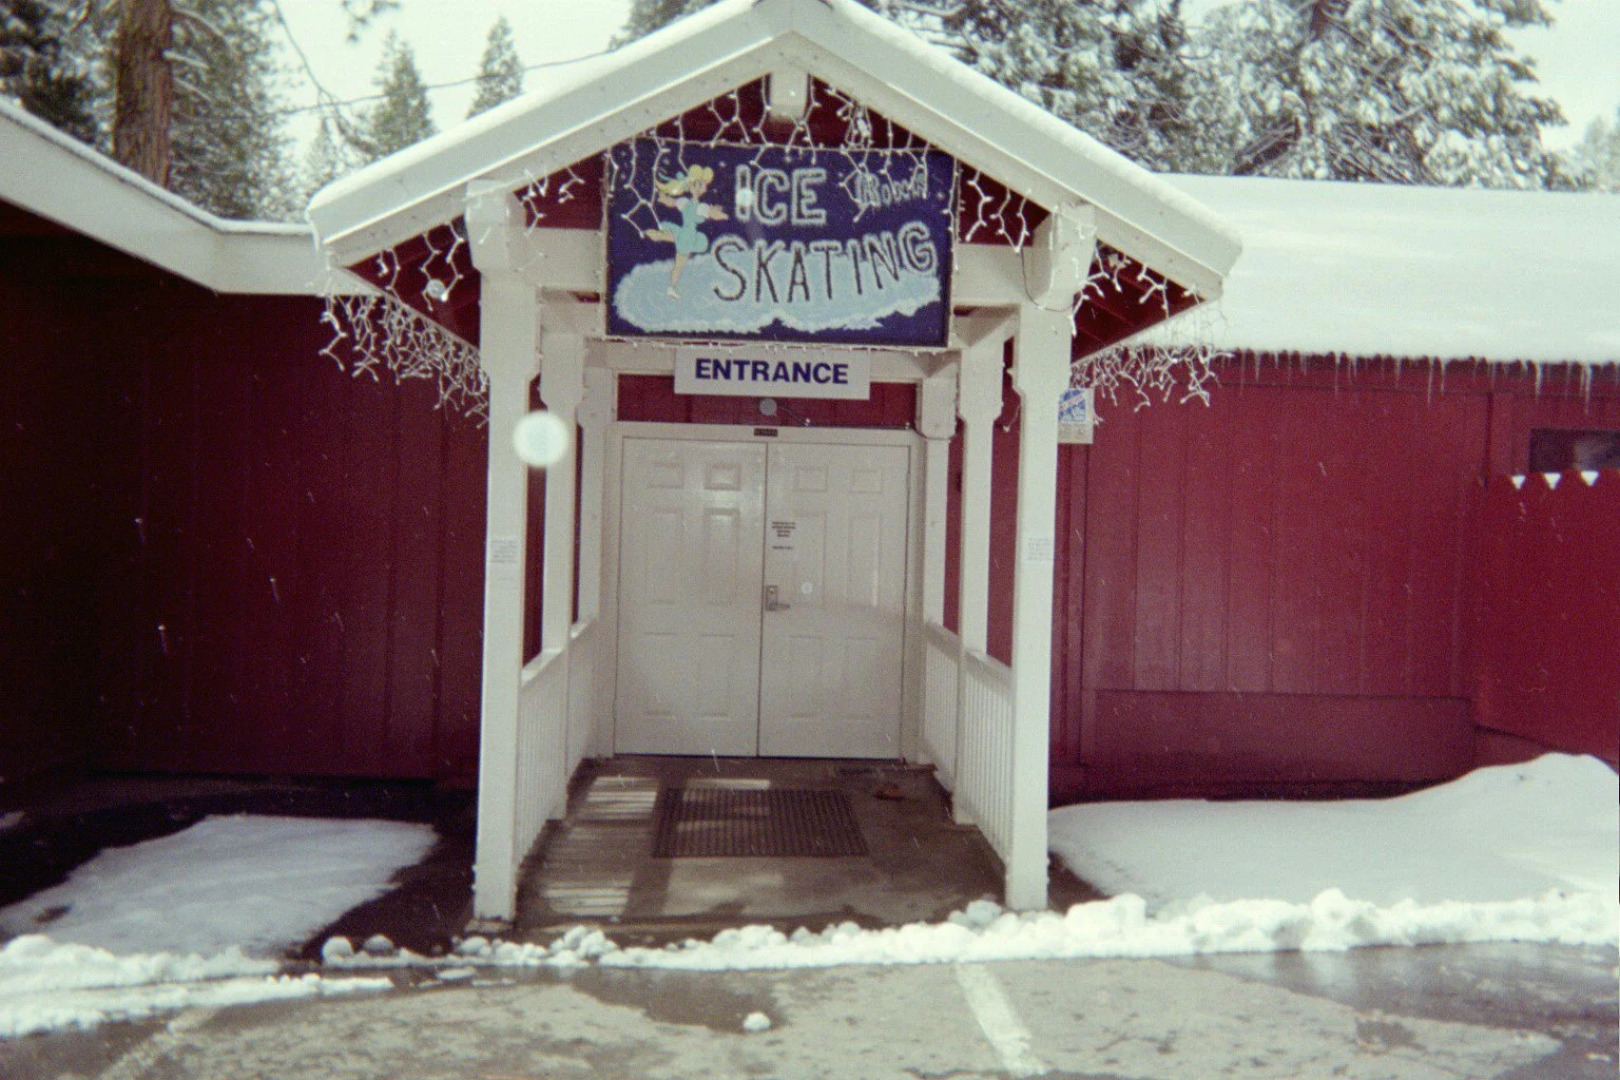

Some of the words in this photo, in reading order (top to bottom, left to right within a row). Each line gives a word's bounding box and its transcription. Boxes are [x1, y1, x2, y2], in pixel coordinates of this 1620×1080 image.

[735, 164, 827, 226] ICE
[711, 221, 938, 303] SKATING
[695, 358, 849, 385] ENTRANCE
